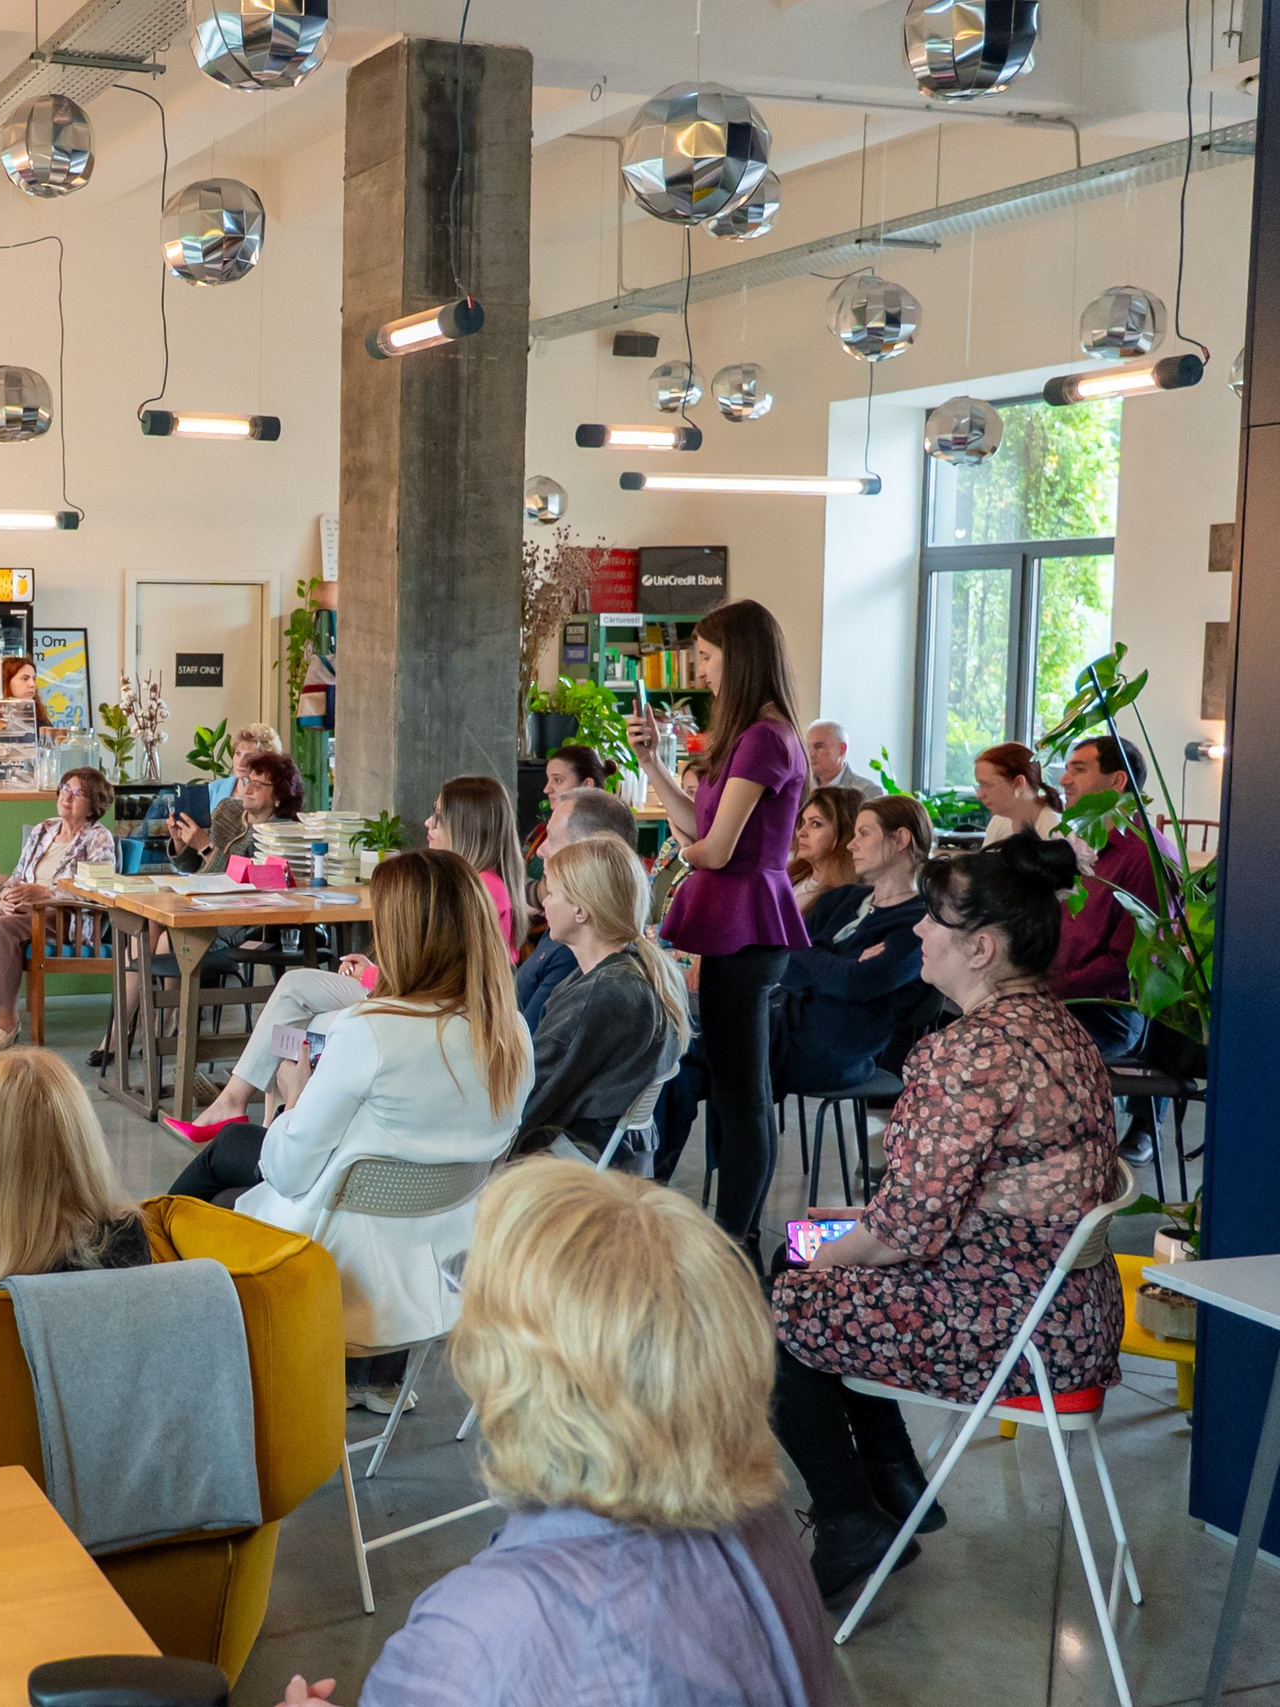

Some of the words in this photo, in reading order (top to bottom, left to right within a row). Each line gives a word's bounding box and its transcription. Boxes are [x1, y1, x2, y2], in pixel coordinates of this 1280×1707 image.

[653, 575, 696, 586] UniCredit
[697, 574, 723, 586] Bank
[41, 635, 67, 648] Om
[177, 665, 199, 674] STAFF
[199, 666, 221, 675] ONLY
